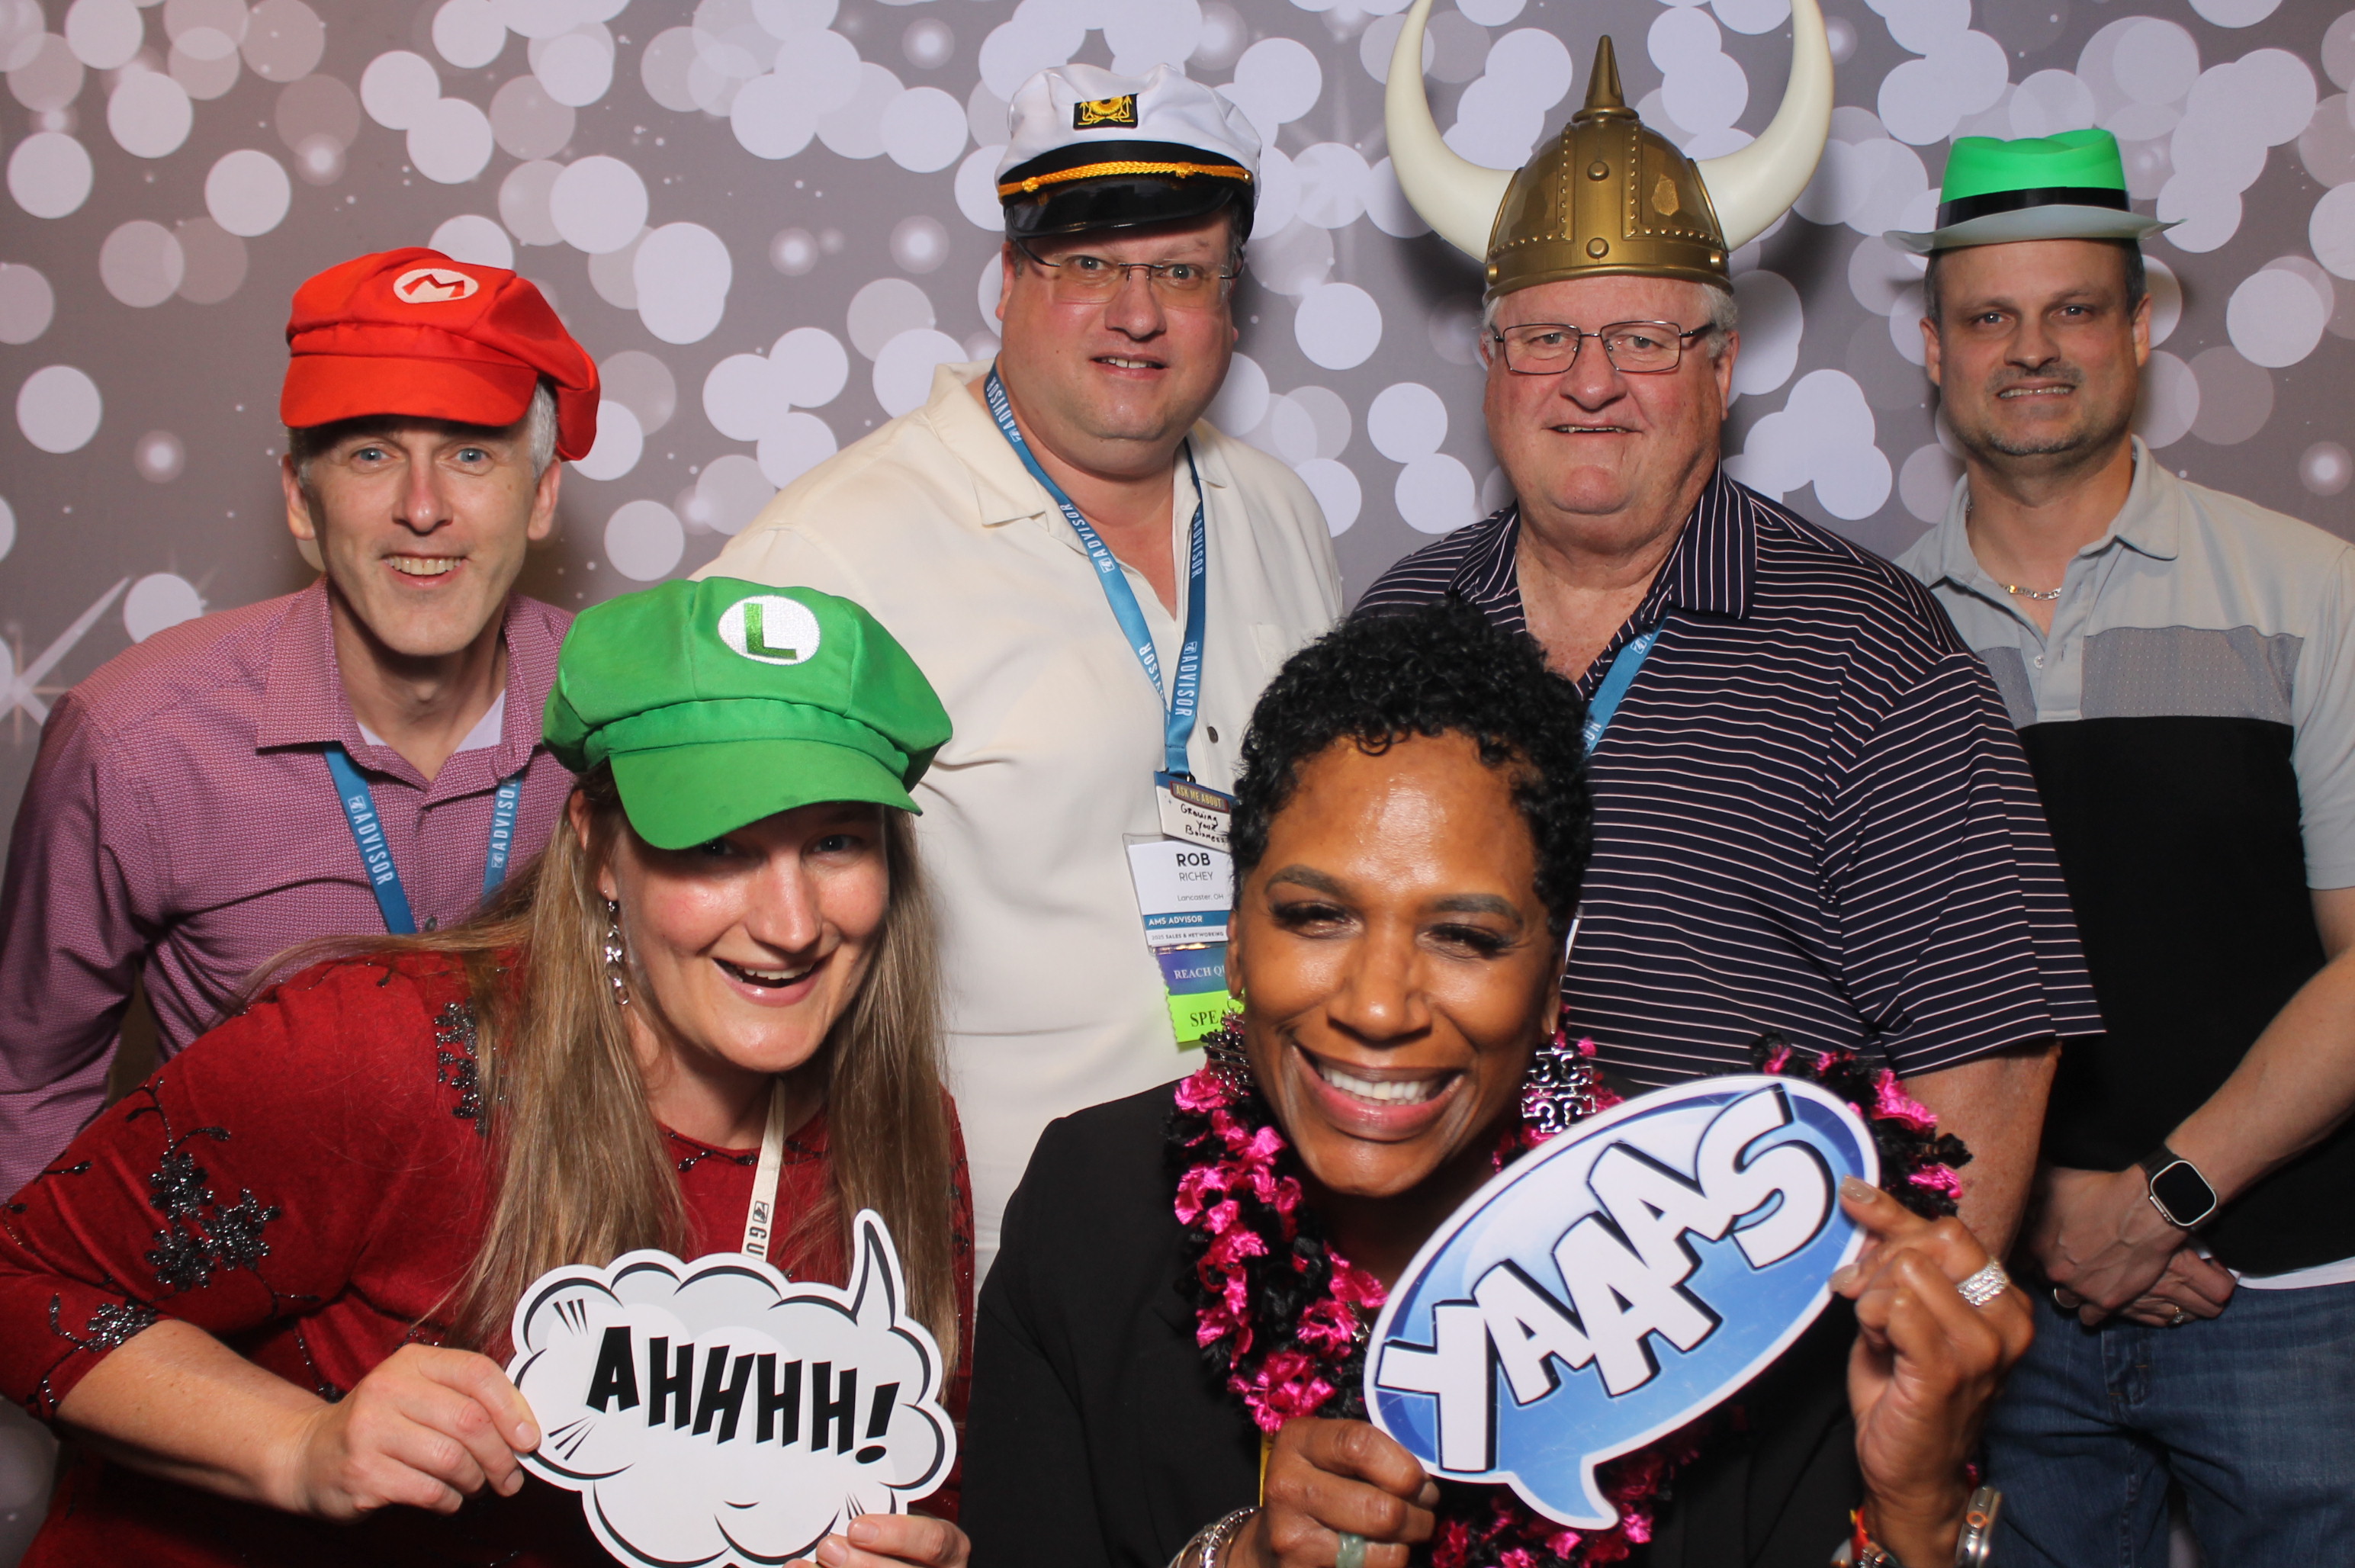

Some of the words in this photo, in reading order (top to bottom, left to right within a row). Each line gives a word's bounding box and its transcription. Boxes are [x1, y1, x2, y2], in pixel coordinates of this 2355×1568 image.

[402, 274, 464, 298] M
[986, 377, 1014, 430] ADVISOR
[1059, 503, 1107, 558] ADVISOR
[1191, 519, 1203, 579] ADVISOR
[744, 602, 797, 660] L
[1175, 655, 1197, 716] ADVISOR
[492, 778, 517, 851] ADVISOR
[1176, 786, 1189, 798] ASK
[1190, 790, 1200, 802] ME
[1201, 791, 1221, 808] ABOUT
[353, 812, 394, 885] ADVISOR
[1175, 853, 1211, 867] ROB
[1178, 871, 1213, 882] RICHEY
[1149, 917, 1167, 926] AMS
[1168, 915, 1203, 924] ADVISOR
[1174, 966, 1212, 980] REACH
[1376, 1083, 1836, 1473] YAAAS
[585, 1325, 901, 1464] AHHHH!
